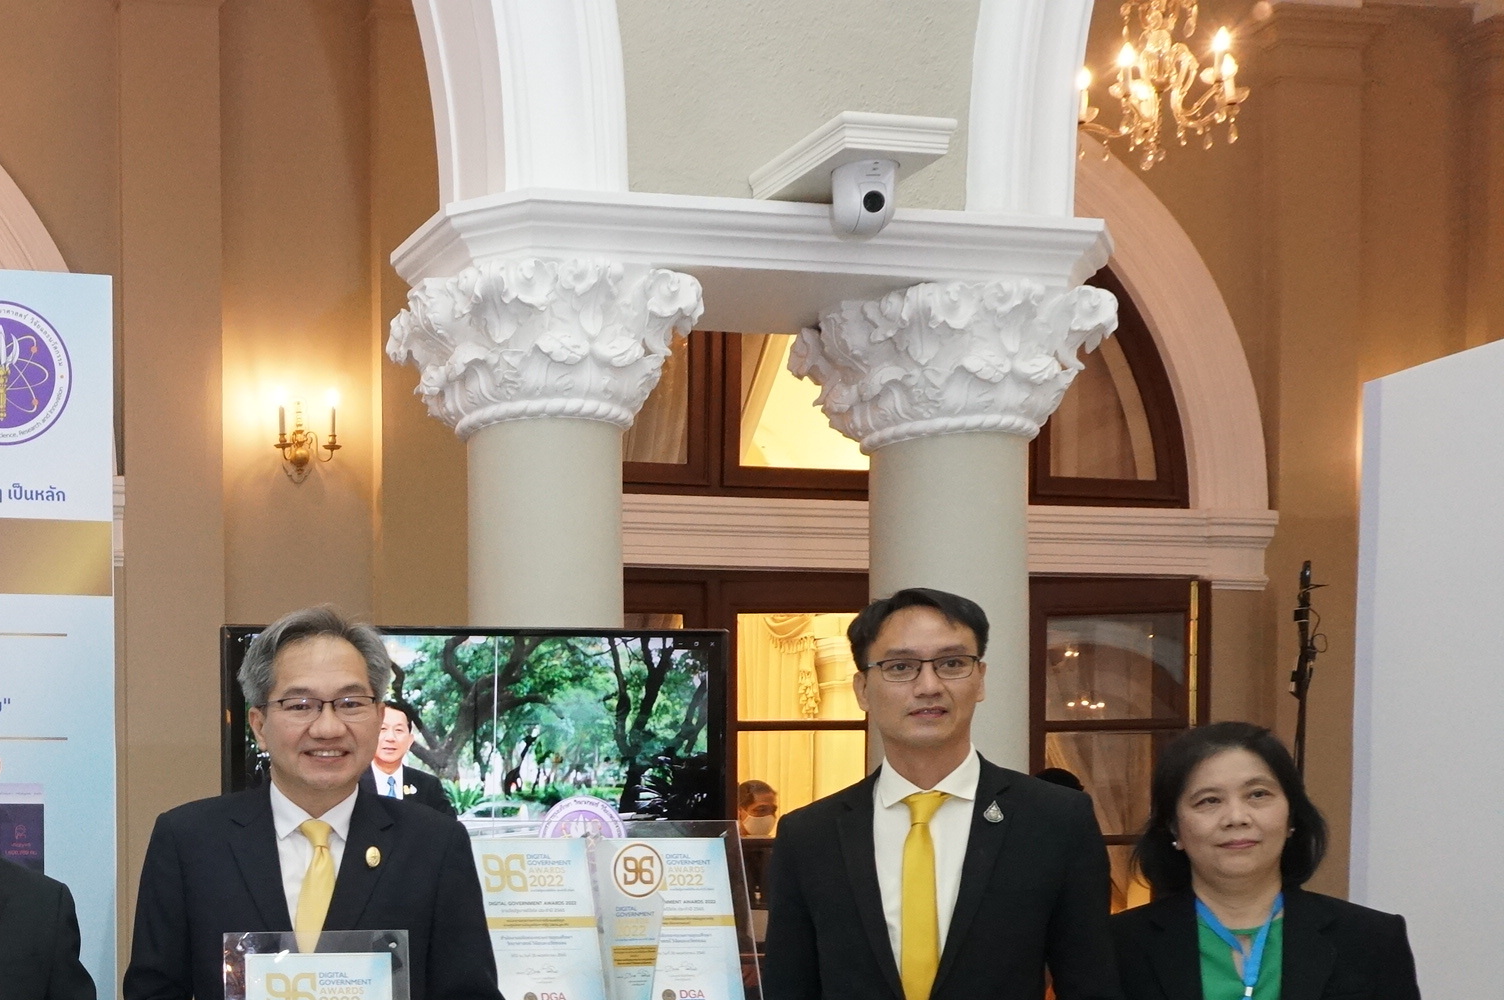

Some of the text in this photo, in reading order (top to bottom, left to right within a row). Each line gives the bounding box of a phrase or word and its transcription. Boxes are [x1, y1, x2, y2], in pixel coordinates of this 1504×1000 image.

[7, 482, 66, 502] เป็นหลัก
[528, 875, 564, 887] 2022
[668, 874, 704, 886] 2022
[318, 971, 348, 979] DIGITAL
[319, 987, 365, 995] AWARDS
[679, 989, 705, 1000] DGA
